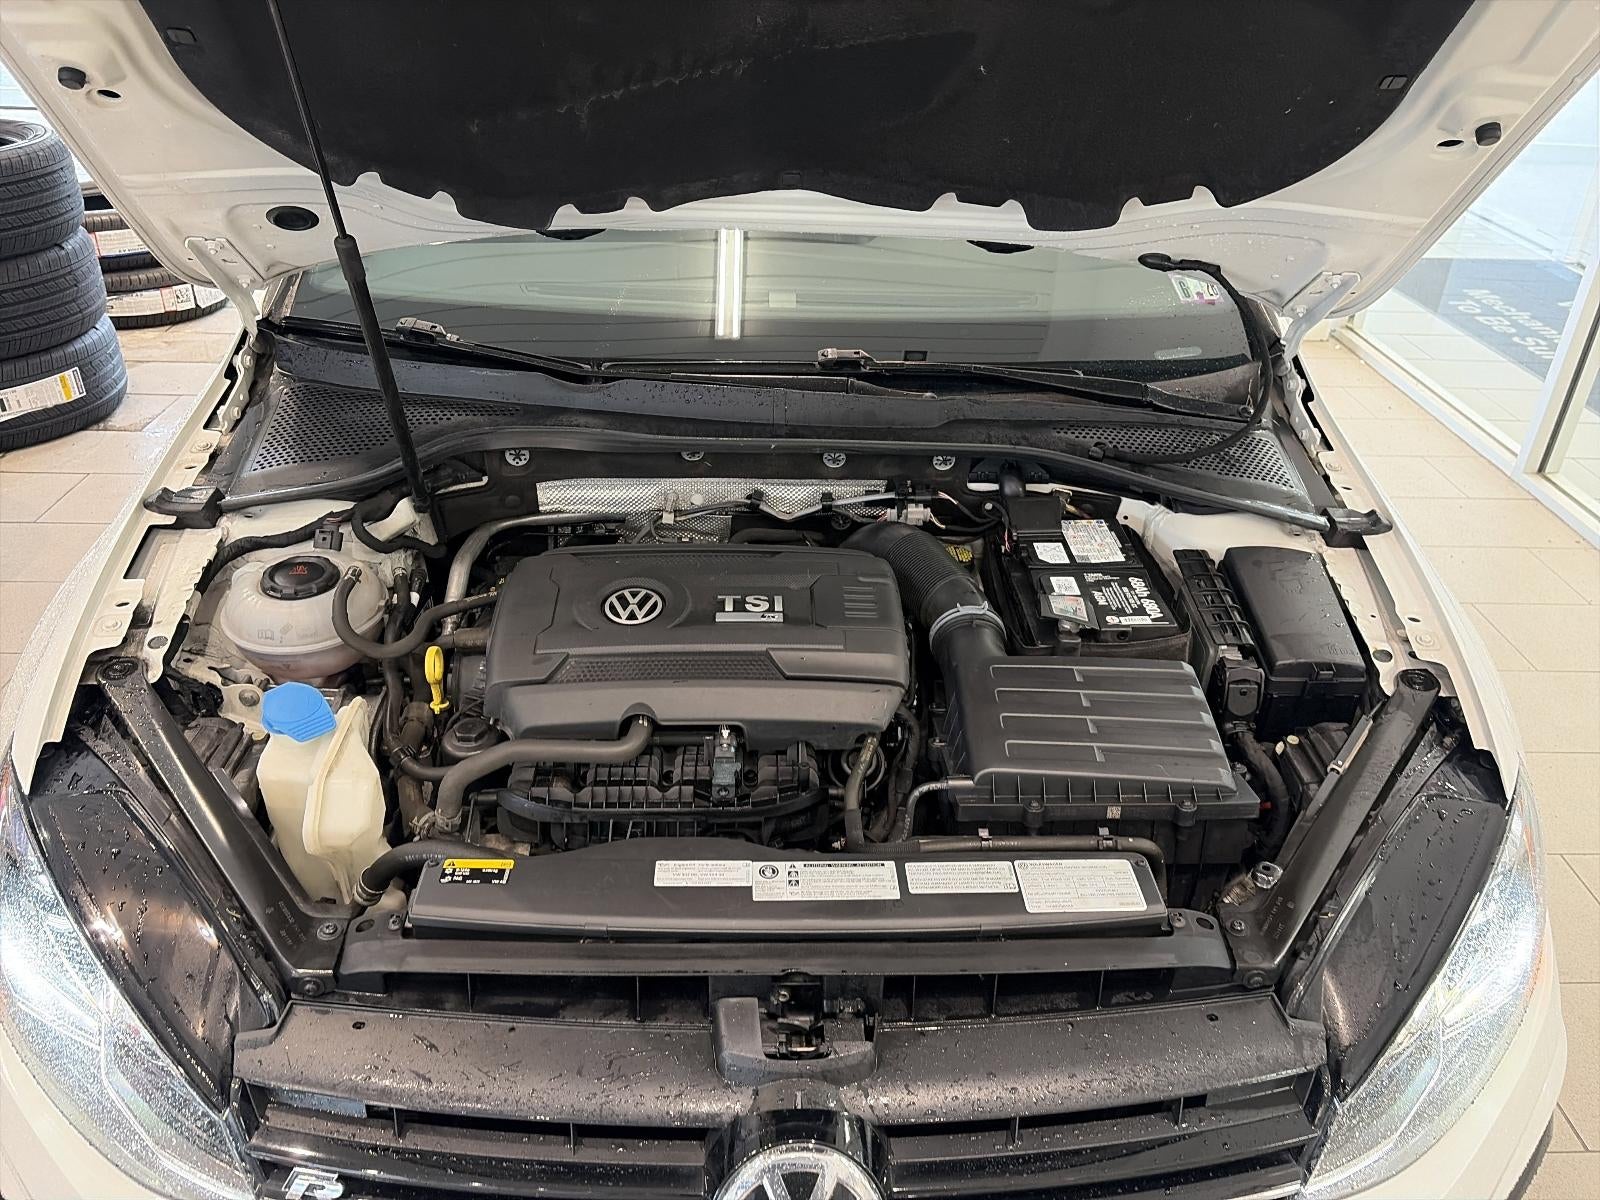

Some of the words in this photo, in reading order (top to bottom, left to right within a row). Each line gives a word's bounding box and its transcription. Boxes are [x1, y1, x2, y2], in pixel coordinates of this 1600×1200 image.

[1448, 300, 1482, 313] To
[1474, 315, 1517, 334] Be
[1462, 289, 1562, 343] Mechani
[604, 587, 664, 625] VW
[717, 595, 783, 612] TSI
